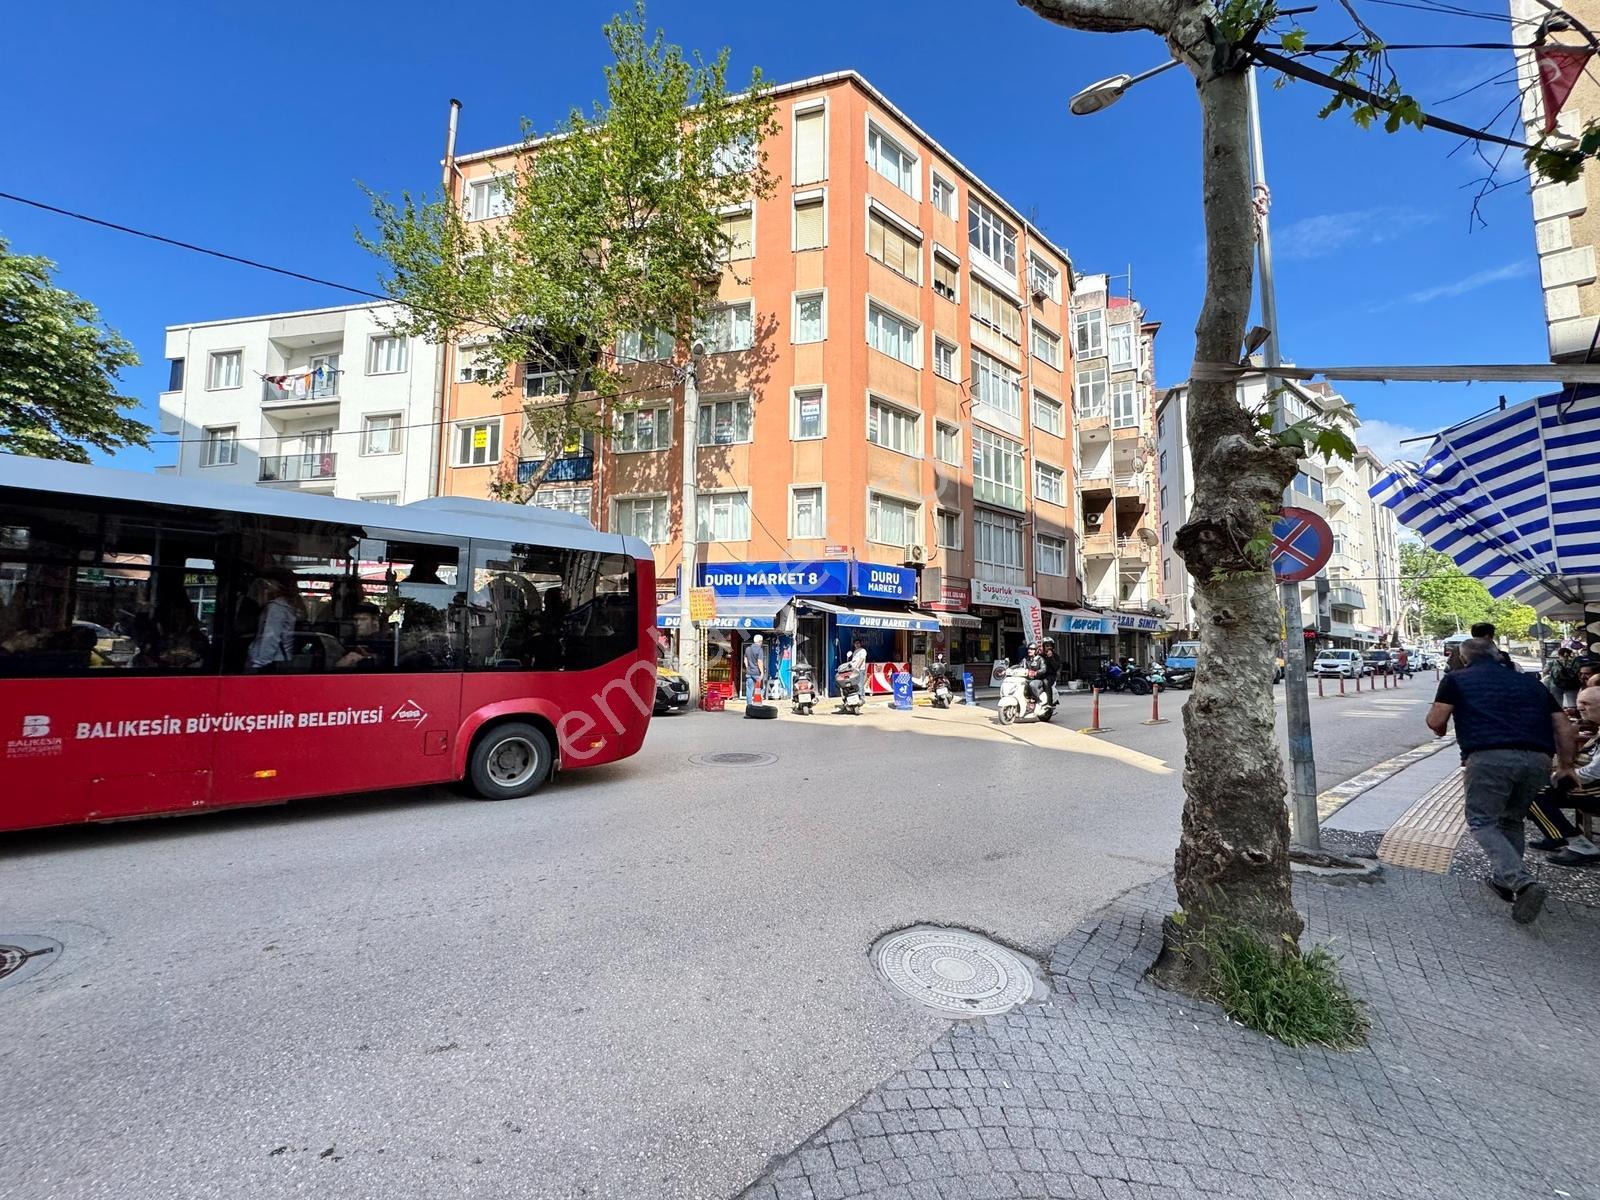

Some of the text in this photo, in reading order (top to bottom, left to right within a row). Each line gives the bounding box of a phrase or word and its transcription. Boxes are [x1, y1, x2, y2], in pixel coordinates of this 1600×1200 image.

[705, 572, 818, 586] DURU MARKET 8
[871, 570, 900, 585] DURU
[868, 582, 903, 594] MARKET 8
[983, 583, 1013, 595] Susurluk
[744, 618, 752, 627] 8
[860, 616, 881, 626] DURU
[882, 619, 910, 628] MARKET
[75, 706, 383, 739] BALIKESİR BÜYÜKŞEHİR BELEDİYESİ
